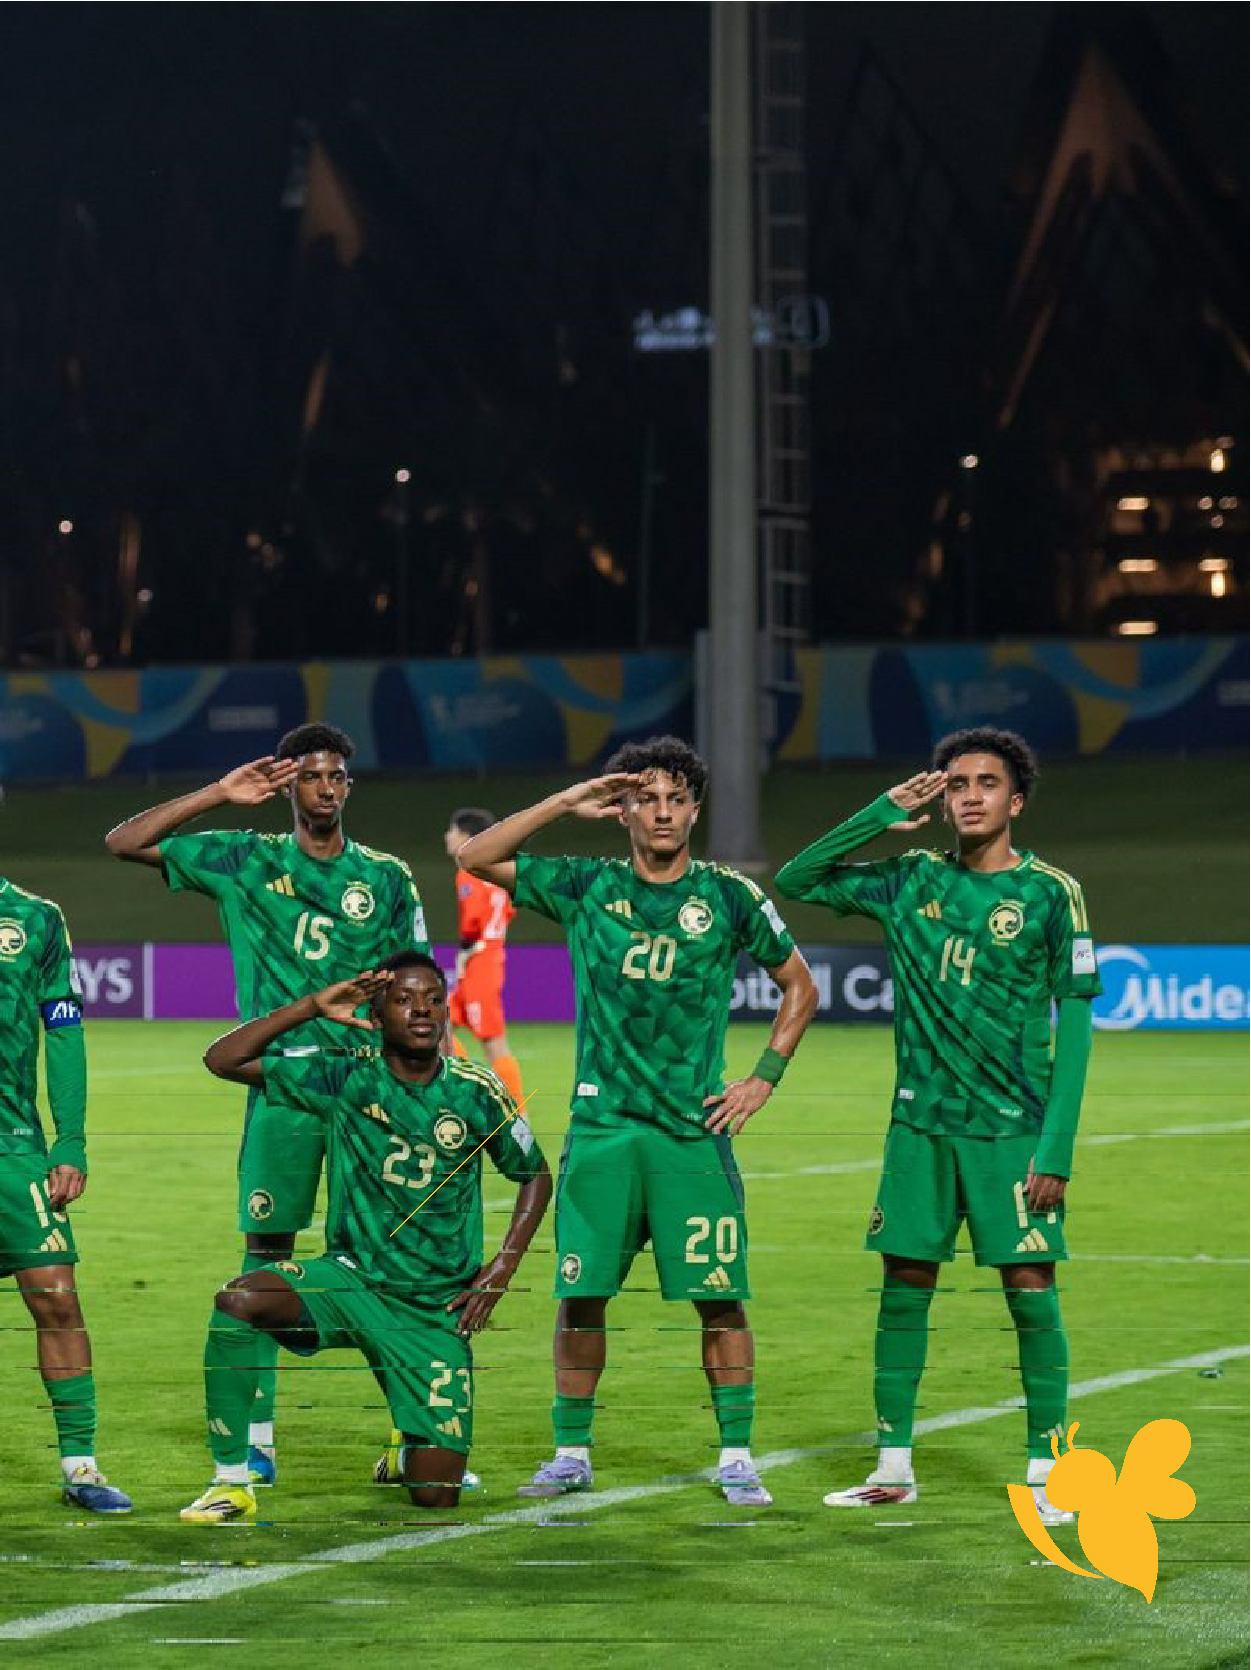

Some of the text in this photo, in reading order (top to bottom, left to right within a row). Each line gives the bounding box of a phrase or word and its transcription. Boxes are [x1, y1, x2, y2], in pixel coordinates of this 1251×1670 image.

[293, 911, 334, 960] 15
[621, 931, 677, 981] 20
[937, 934, 976, 985] 14
[76, 956, 134, 1003] YS
[1116, 972, 1249, 1020] Mide
[49, 1000, 80, 1021] AF
[382, 1134, 437, 1189] 23
[685, 1216, 738, 1264] 20
